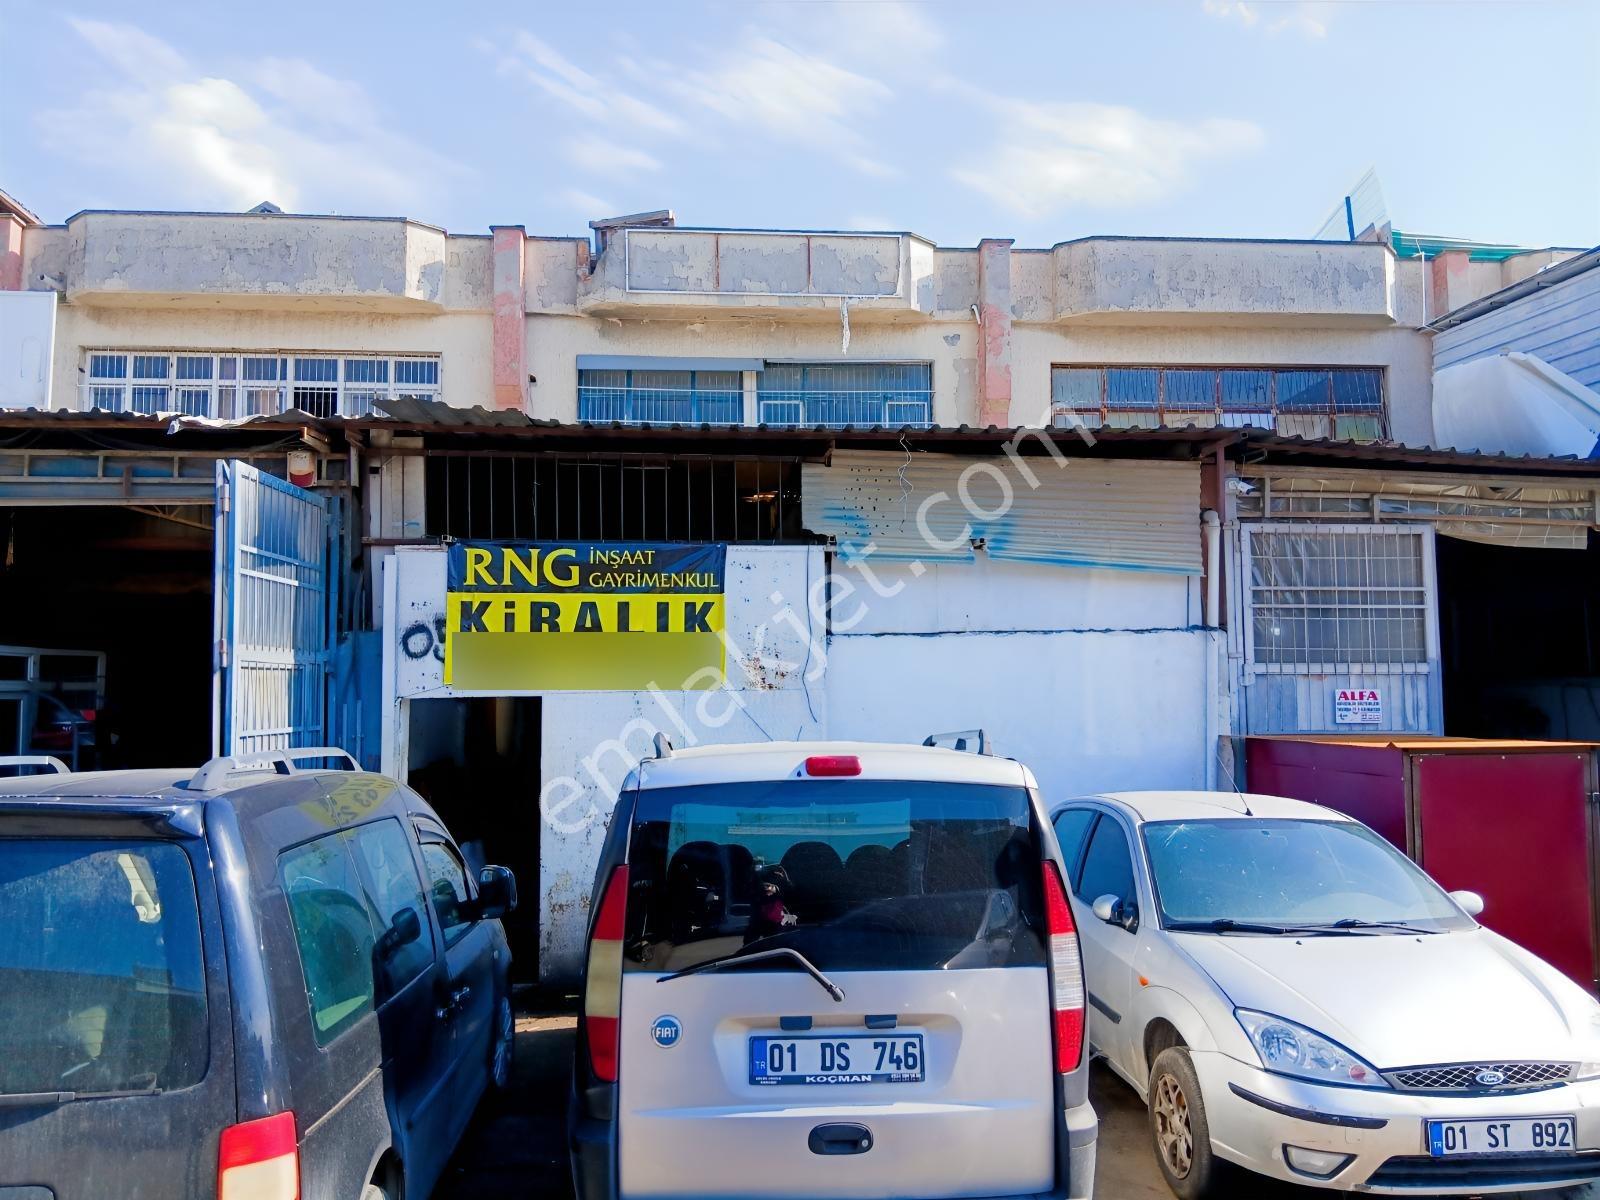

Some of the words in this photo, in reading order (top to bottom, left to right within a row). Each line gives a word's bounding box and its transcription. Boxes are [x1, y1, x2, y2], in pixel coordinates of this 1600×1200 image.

[463, 547, 580, 587] RNG
[589, 546, 655, 568] İNŞAAT
[589, 569, 719, 588] GAYRİMENKUL
[1338, 690, 1378, 701] ALFA
[656, 1026, 678, 1038] FIAT
[755, 1061, 766, 1070] TR
[769, 1043, 797, 1072] 01
[820, 1042, 850, 1072] DS
[873, 1041, 918, 1071] 746
[805, 1074, 872, 1084] KOÇMAN
[1444, 1125, 1468, 1150] 01
[1486, 1123, 1511, 1148] ST
[1531, 1122, 1571, 1148] 892
